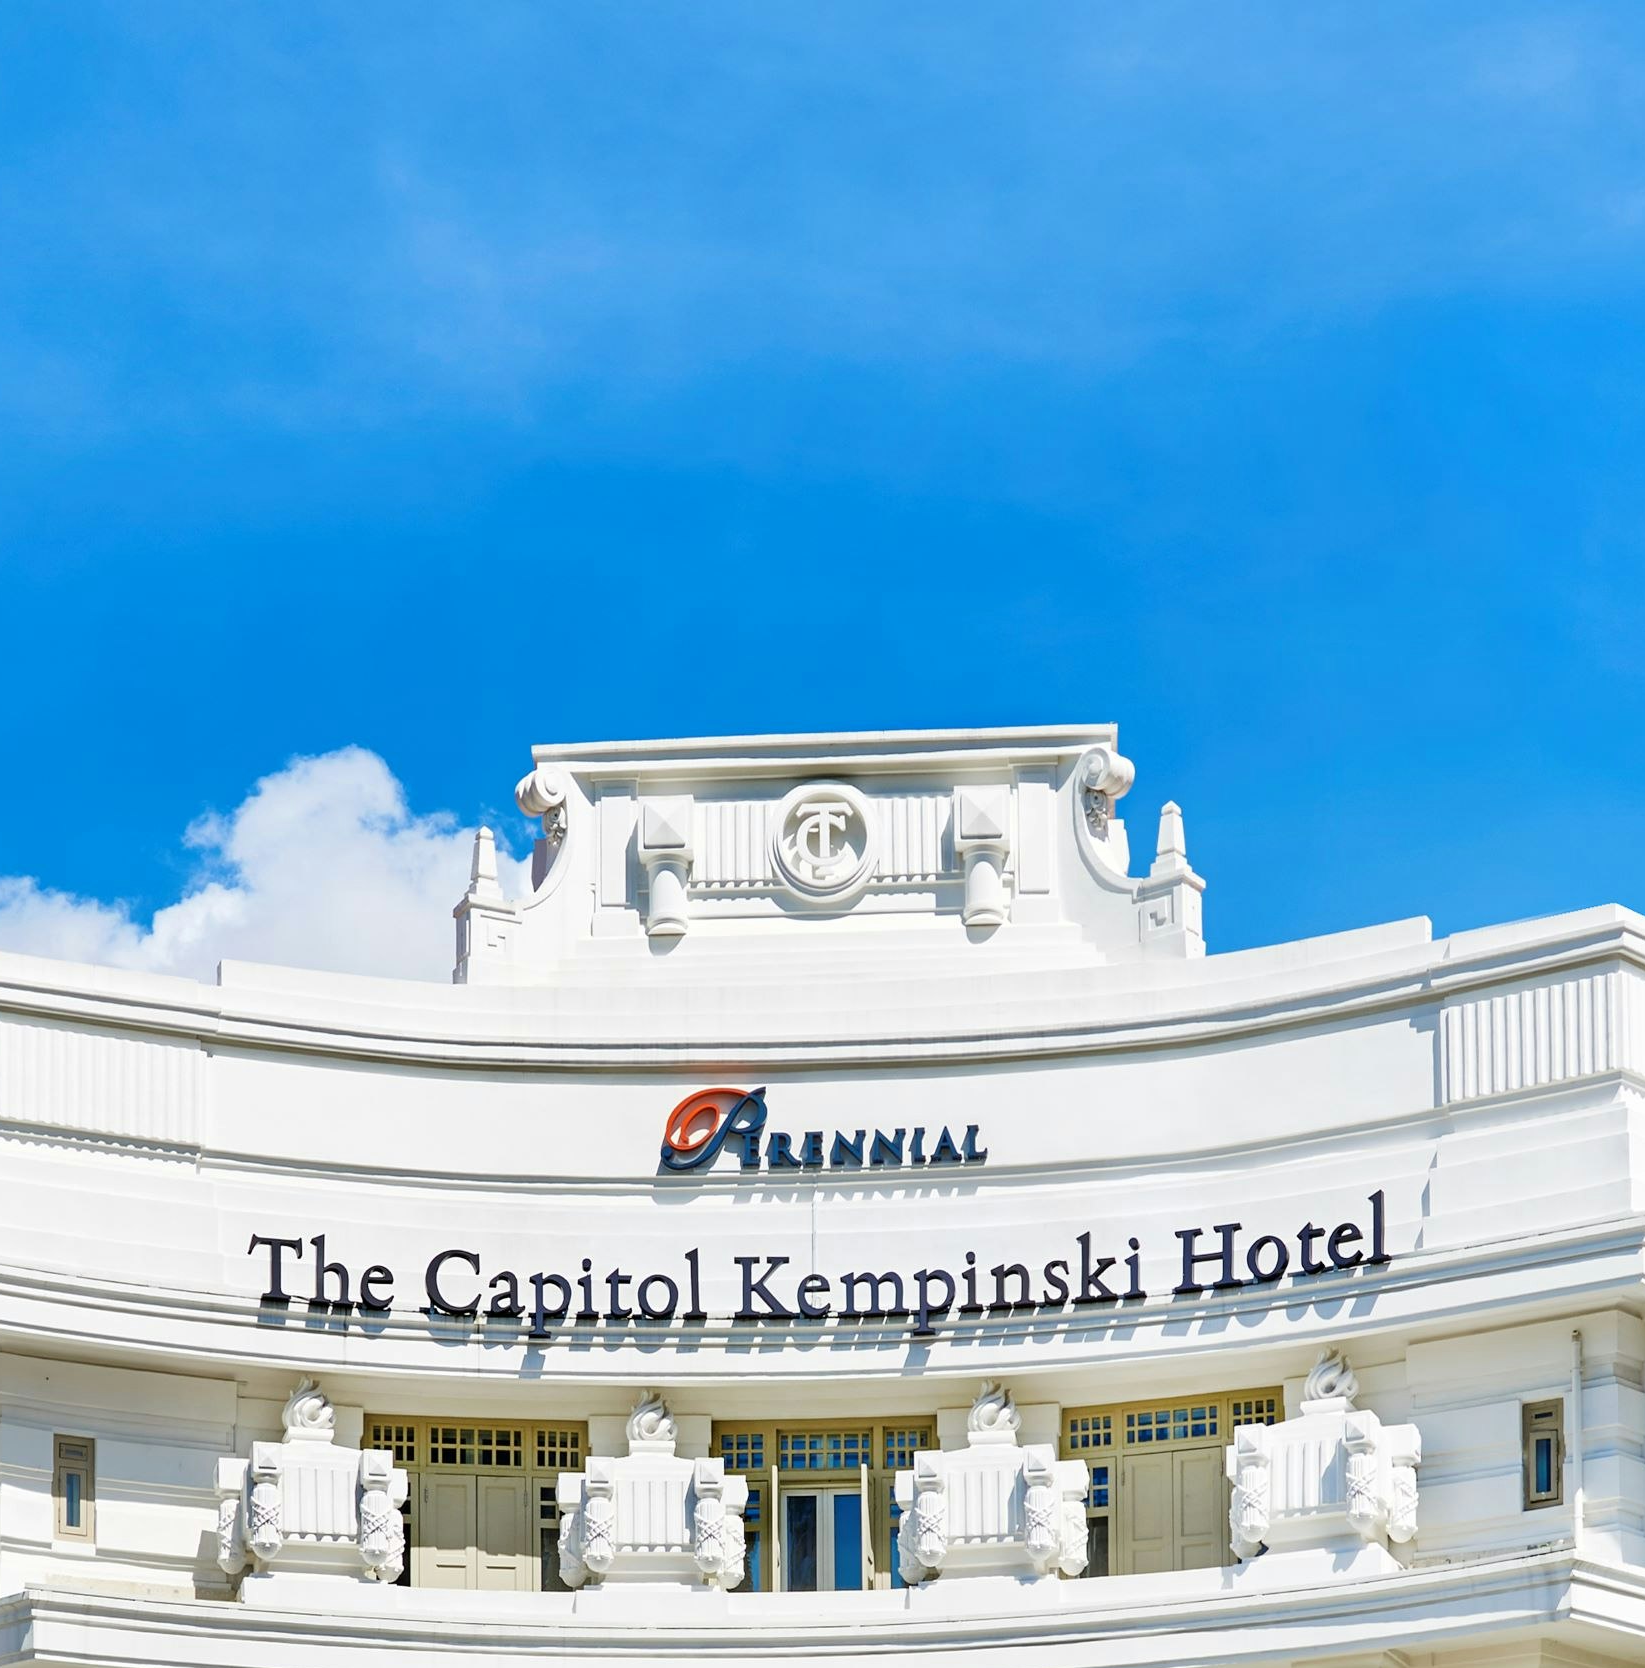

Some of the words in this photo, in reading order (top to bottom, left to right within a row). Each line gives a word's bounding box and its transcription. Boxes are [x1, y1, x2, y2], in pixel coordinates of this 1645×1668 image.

[661, 1086, 988, 1170] PERENNIAL
[247, 1233, 395, 1311] The
[424, 1247, 708, 1339] Capitol
[733, 1231, 1147, 1336] Kempinski
[1173, 1189, 1392, 1293] Hotel
